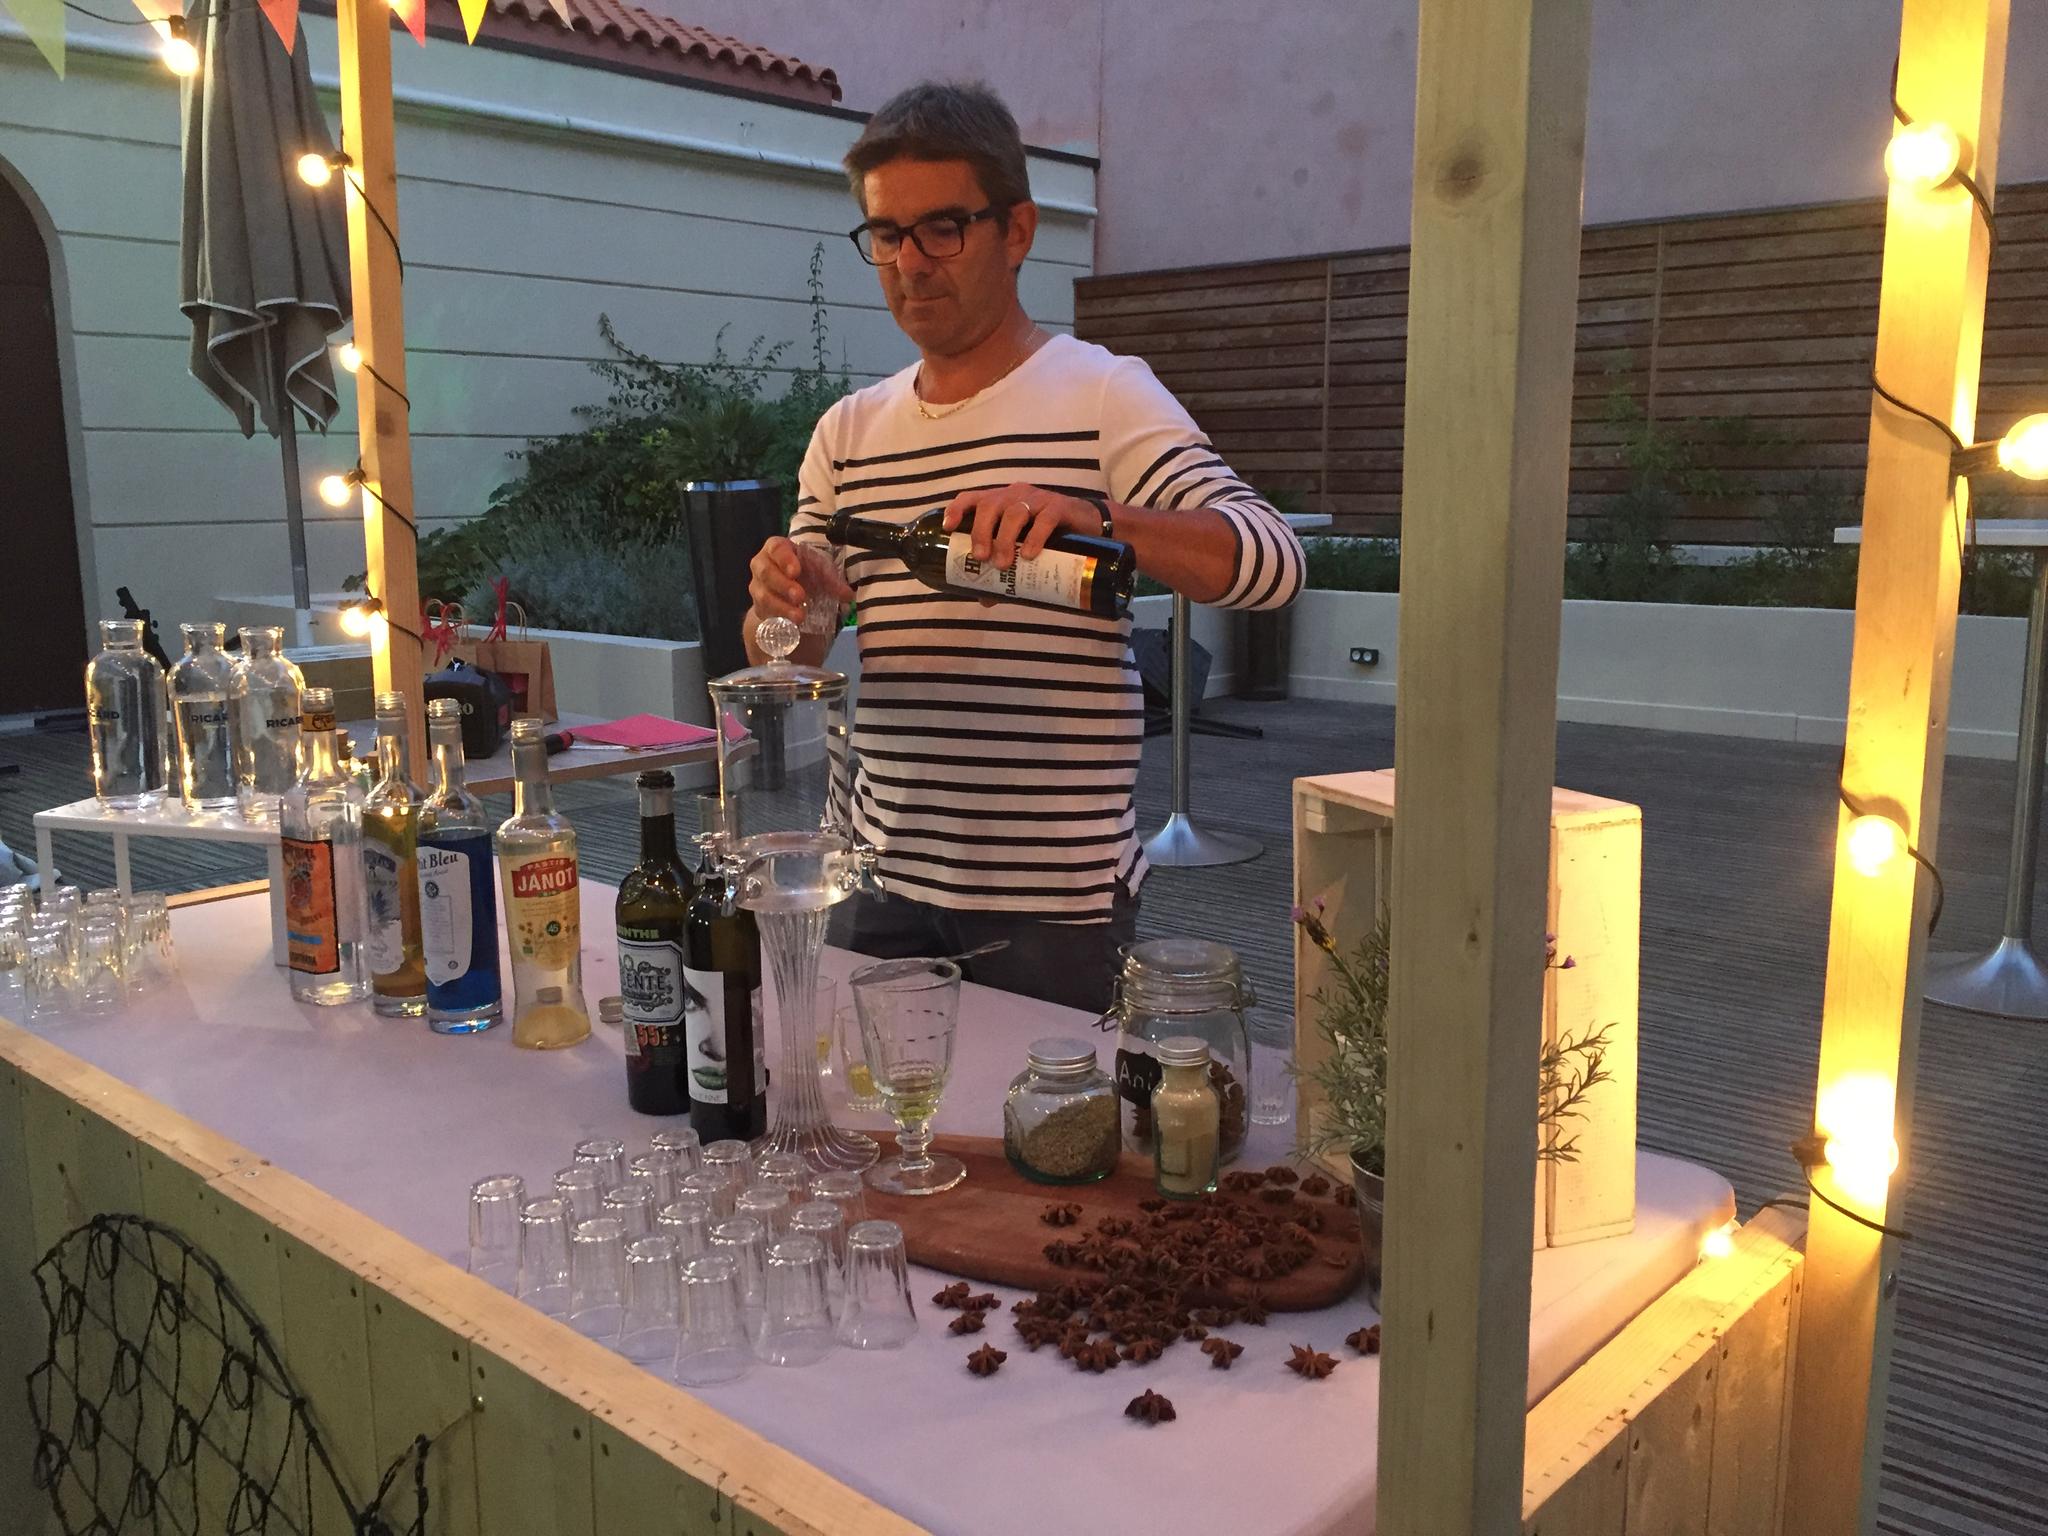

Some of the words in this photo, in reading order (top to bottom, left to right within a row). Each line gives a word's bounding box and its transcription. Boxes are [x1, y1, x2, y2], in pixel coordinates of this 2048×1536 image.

[429, 851, 459, 868] Bleu
[517, 866, 575, 892] JANOT
[1119, 1059, 1153, 1092] Ani
